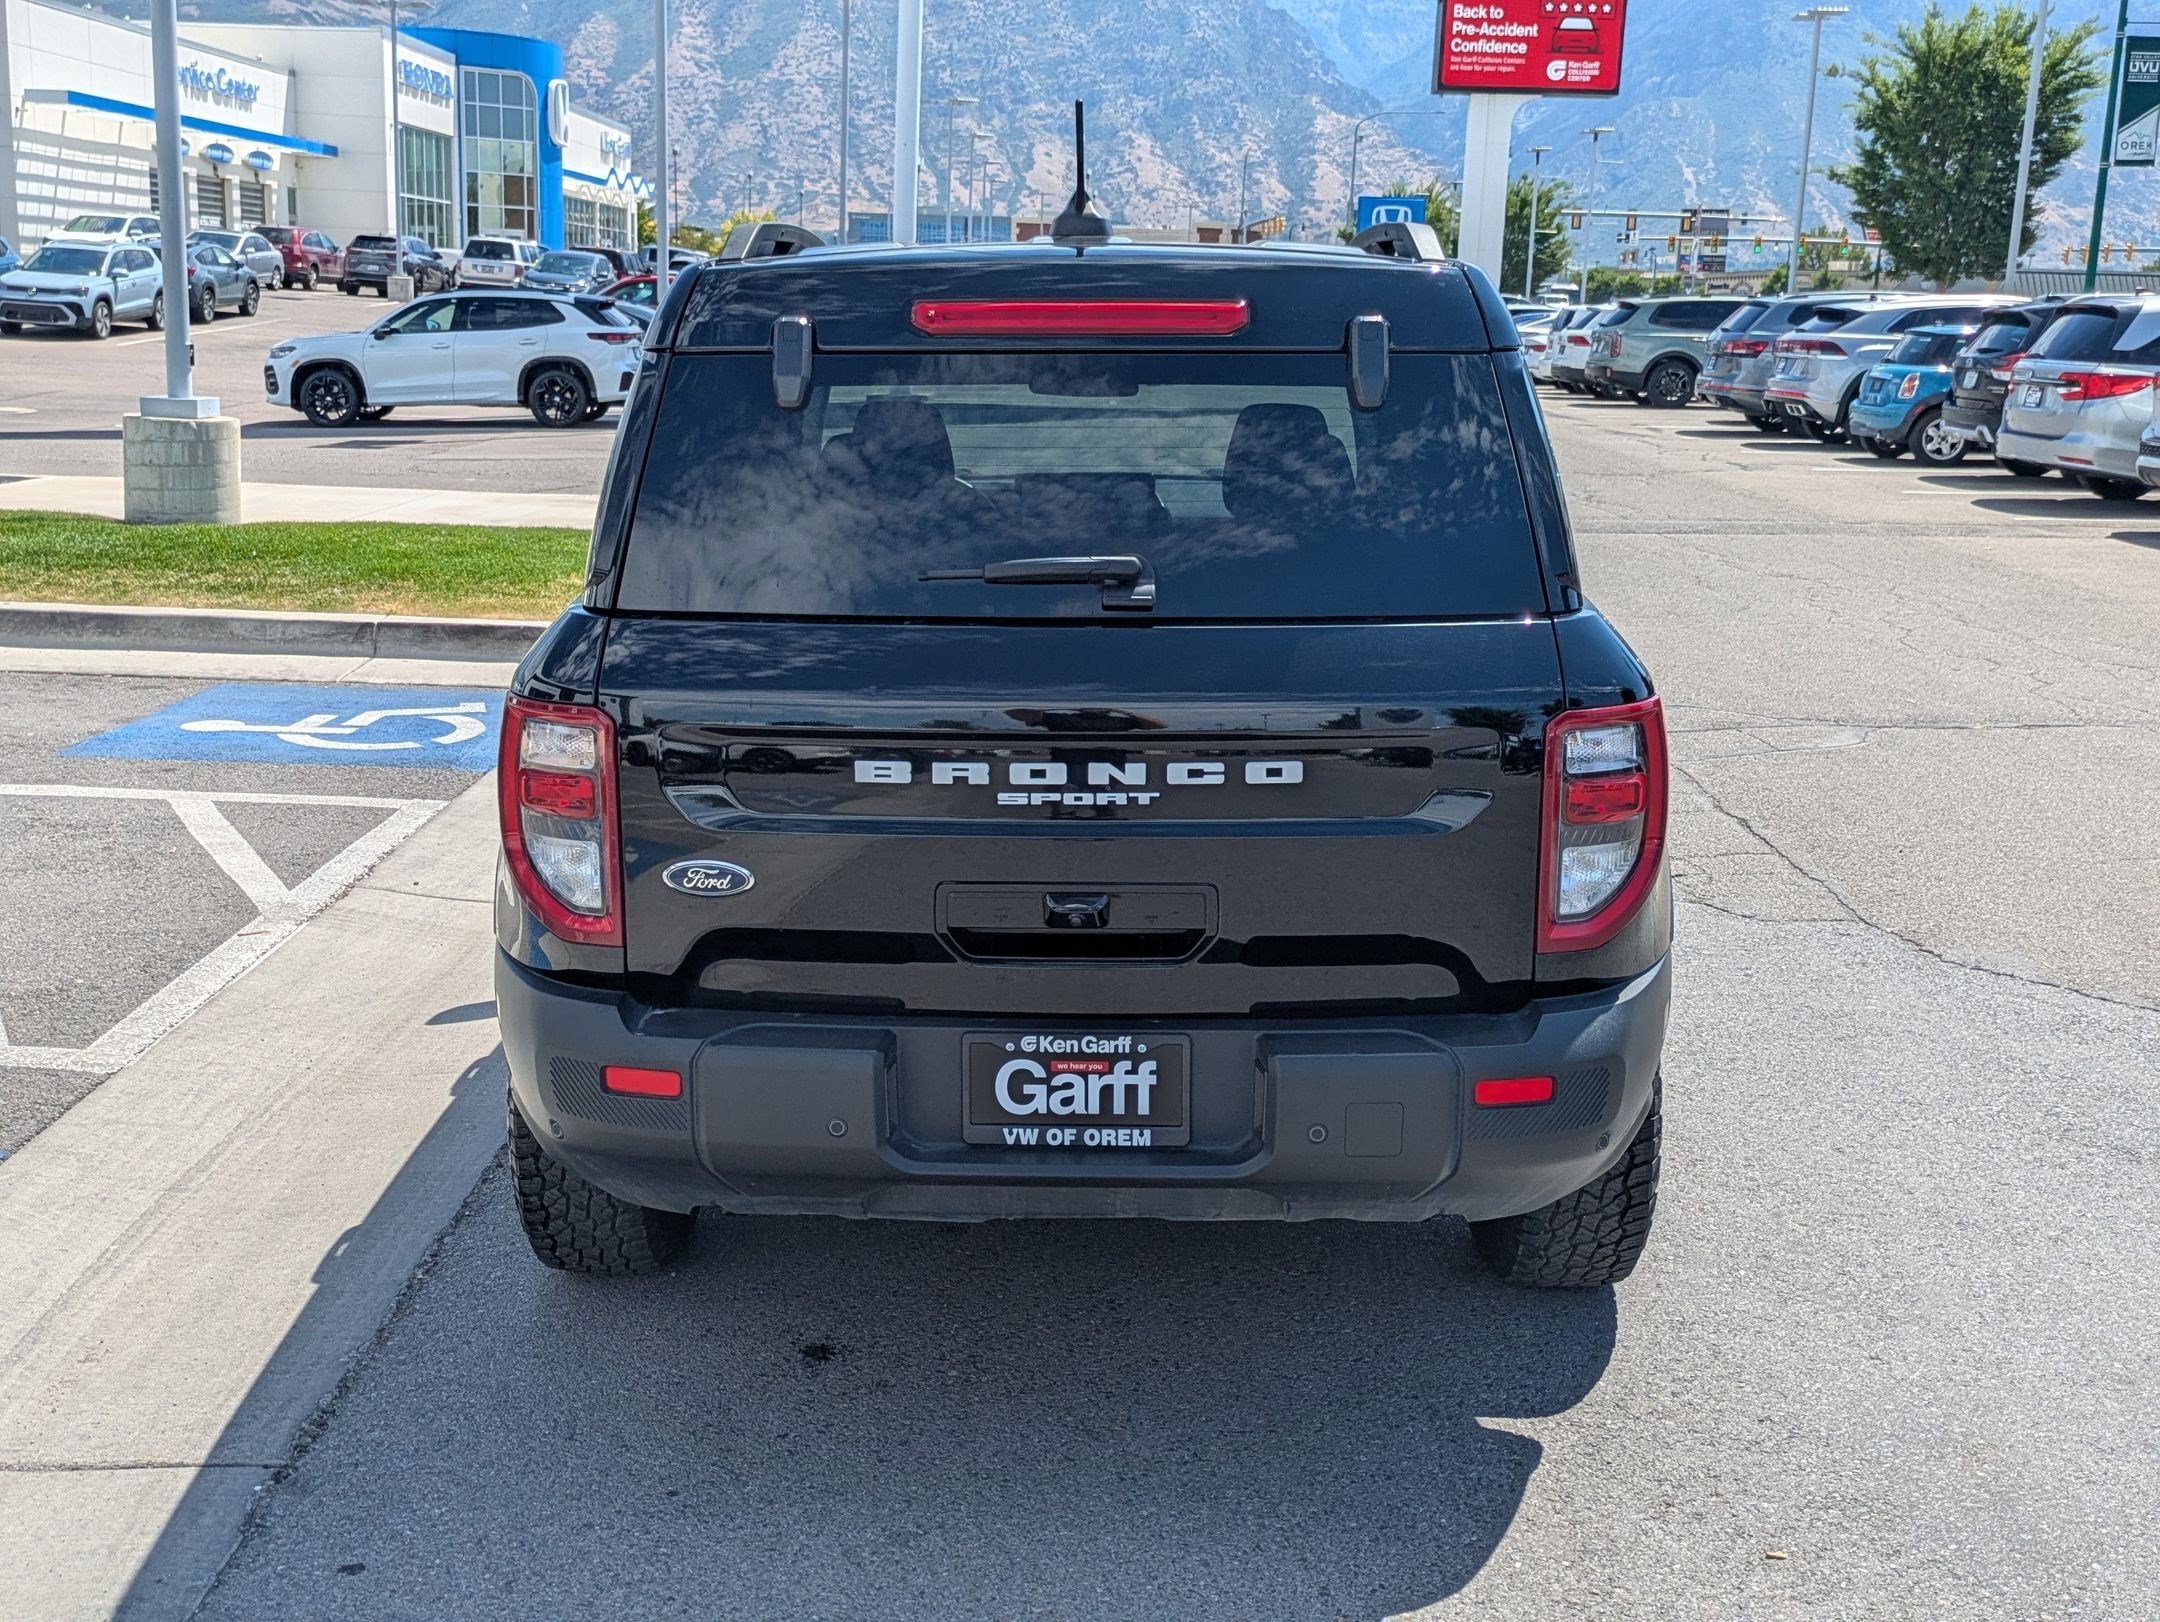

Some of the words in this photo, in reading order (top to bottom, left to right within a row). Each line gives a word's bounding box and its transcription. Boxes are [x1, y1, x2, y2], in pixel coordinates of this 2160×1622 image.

[1453, 4, 1488, 18] Back
[1489, 6, 1504, 19] to
[1452, 21, 1538, 38] Pre-Accident
[1450, 38, 1528, 54] Confidence
[1473, 64, 1483, 72] for
[1483, 65, 1497, 73] your
[1568, 61, 1582, 69] Ken
[1582, 61, 1600, 69] Garff
[2129, 61, 2159, 73] UVU
[217, 67, 260, 102] Center
[398, 59, 454, 99] HONDA
[854, 760, 1304, 786] BRONCO
[996, 792, 1160, 805] SPORT
[683, 867, 732, 890] Ford
[1039, 1035, 1079, 1053] Ken
[1081, 1035, 1132, 1054] Garff
[1070, 1062, 1087, 1070] hear
[1088, 1063, 1103, 1071] you
[994, 1058, 1157, 1116] Garff
[1002, 1127, 1039, 1146] VW
[1046, 1128, 1077, 1146] OF
[1083, 1128, 1151, 1146] OREM
